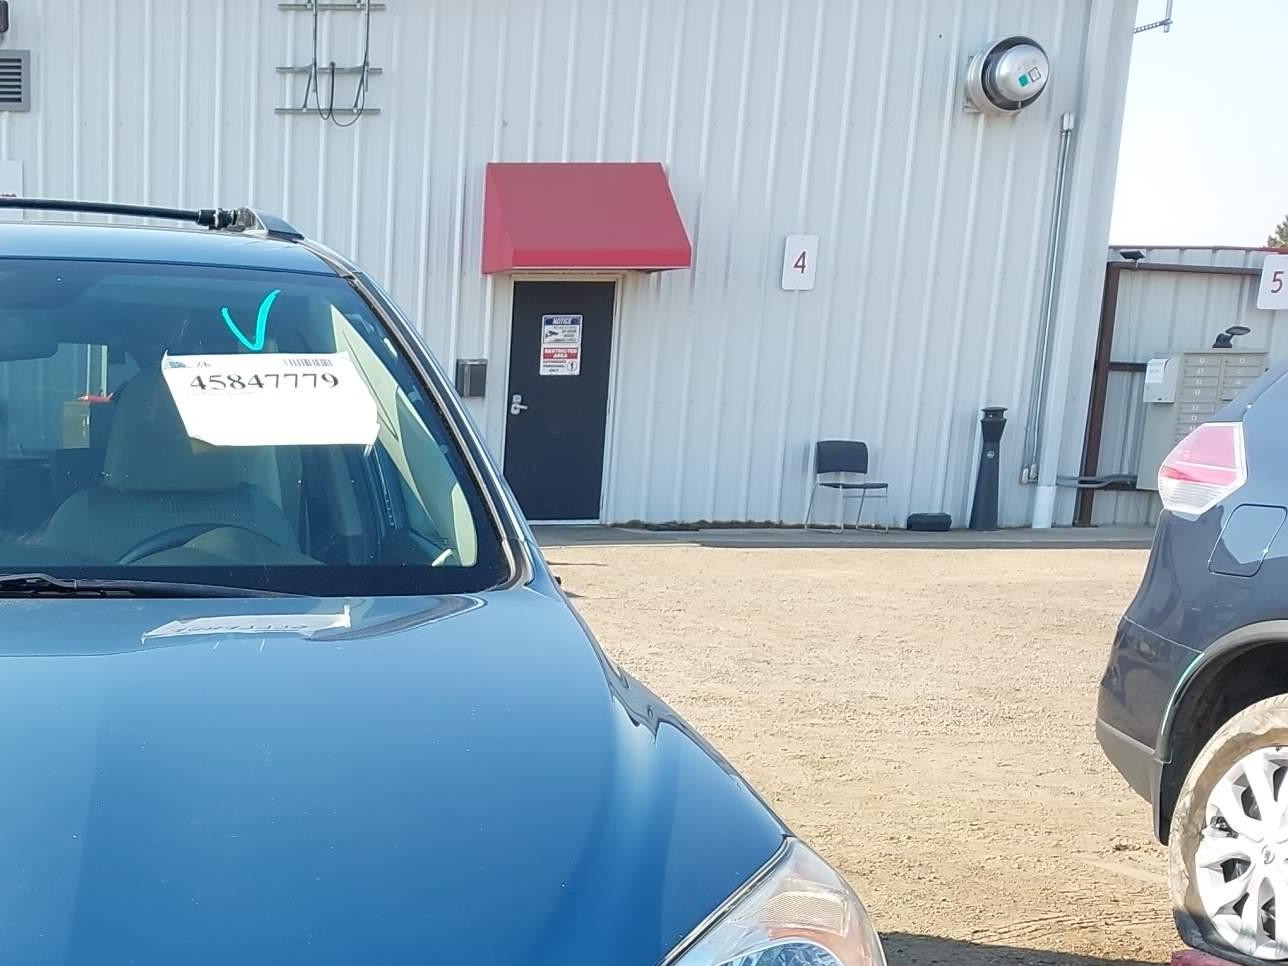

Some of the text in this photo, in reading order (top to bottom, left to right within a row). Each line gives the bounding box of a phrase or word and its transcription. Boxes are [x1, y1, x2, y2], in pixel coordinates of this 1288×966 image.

[793, 250, 807, 274] 4
[1270, 270, 1285, 294] 5
[189, 372, 340, 391] 45847779
